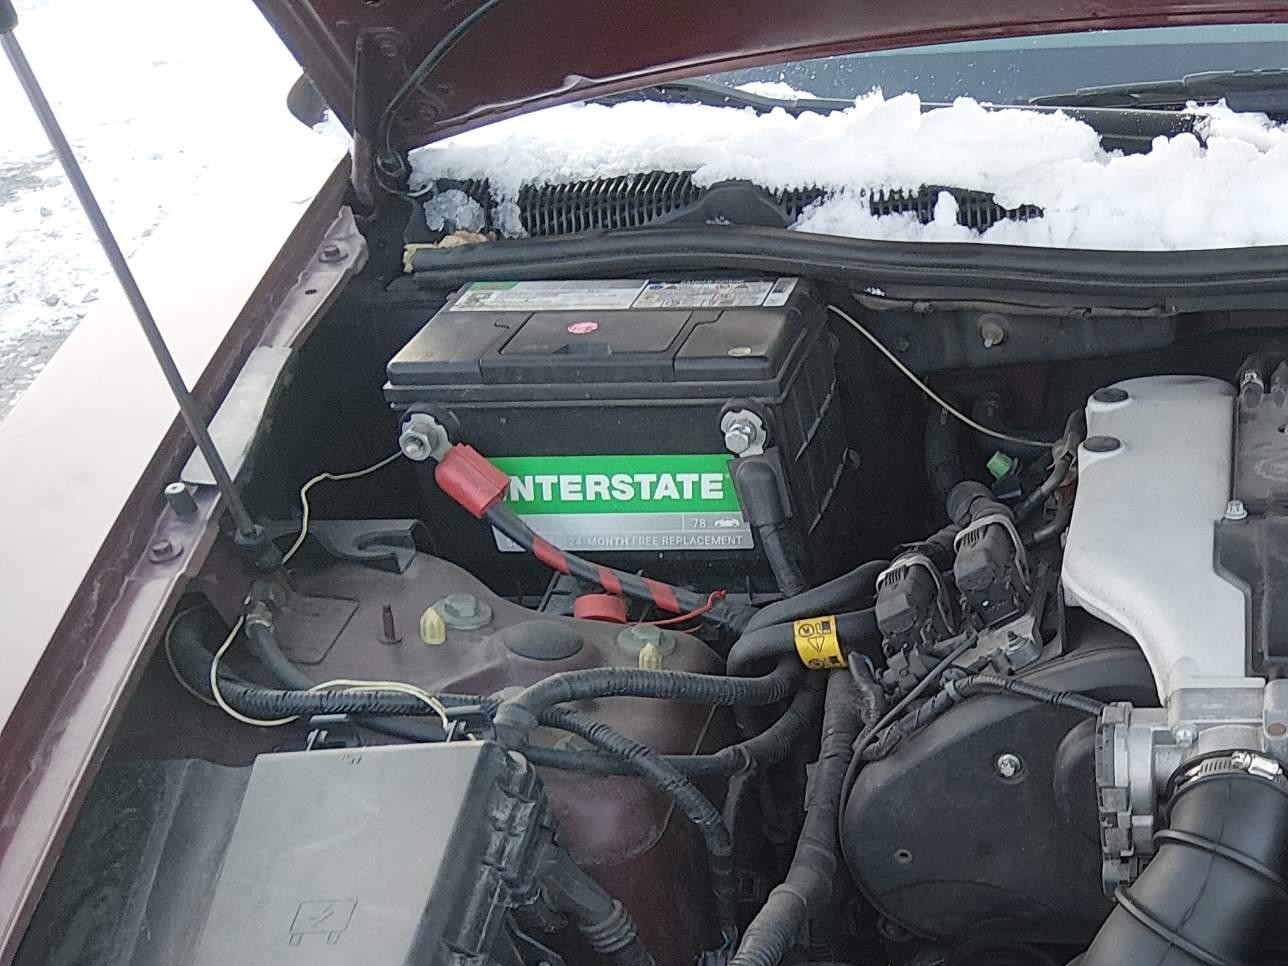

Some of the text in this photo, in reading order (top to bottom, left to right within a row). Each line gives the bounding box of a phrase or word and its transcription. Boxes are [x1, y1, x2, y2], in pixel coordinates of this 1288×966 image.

[692, 517, 707, 529] 78
[632, 535, 659, 547] FREE
[662, 534, 744, 546] REPLACEMENT
